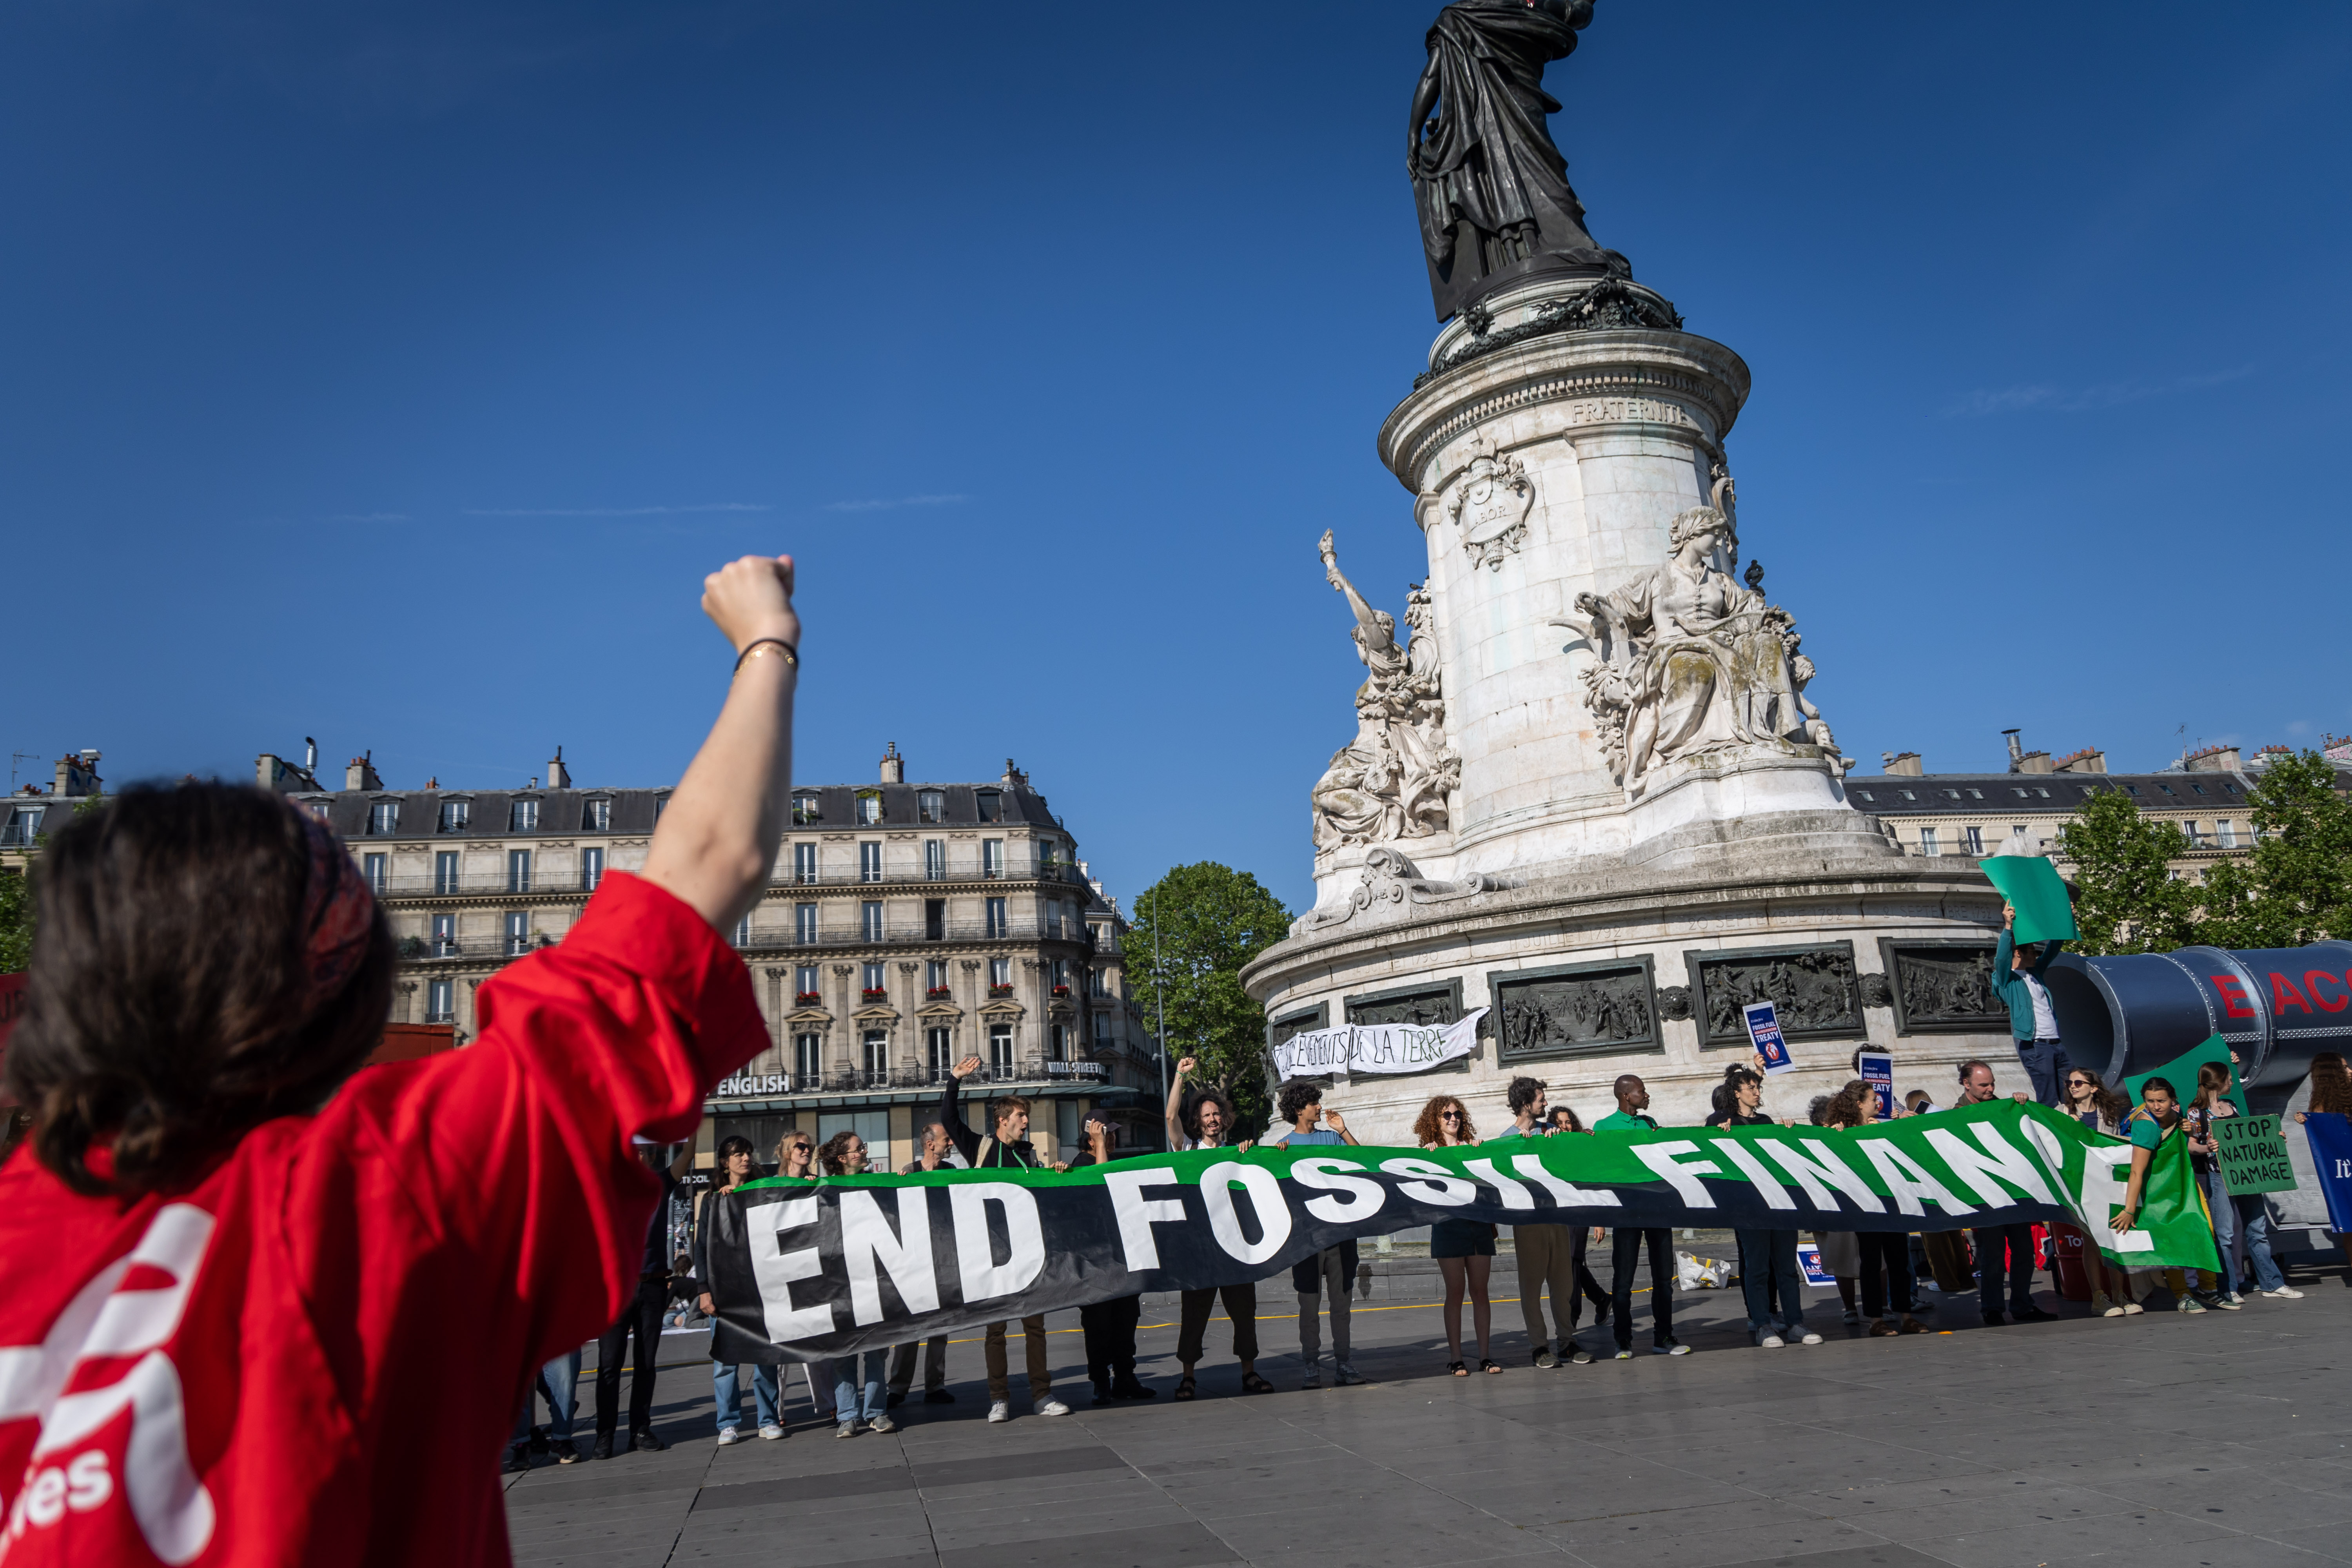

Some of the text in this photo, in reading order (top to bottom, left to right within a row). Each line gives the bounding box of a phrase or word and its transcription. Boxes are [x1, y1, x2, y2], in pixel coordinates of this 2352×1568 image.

[1473, 505, 1507, 528] ABOR
[1688, 917, 1709, 931] 20
[1523, 929, 1583, 948] JUILLET
[1590, 926, 1622, 940] 1792
[1411, 949, 1438, 965] 1790
[1752, 1022, 1766, 1031] FOSSIL
[1373, 1030, 1395, 1064] LA
[1399, 1029, 1446, 1063] TERRE
[1755, 1031, 1779, 1043] TREATY
[1047, 1062, 1070, 1073] WALL
[1072, 1062, 1099, 1073] STREET
[717, 1074, 790, 1095] ENGLISH
[1873, 1083, 1891, 1092] EATY
[2223, 1119, 2270, 1140] STOP
[2221, 1141, 2287, 1163] NATURAL
[2229, 1162, 2291, 1185] DAMAGE
[2335, 1159, 2352, 1178] It'
[746, 1181, 1045, 1344] END
[1103, 1154, 1622, 1272] FOSSIL
[2065, 1235, 2084, 1247] To
